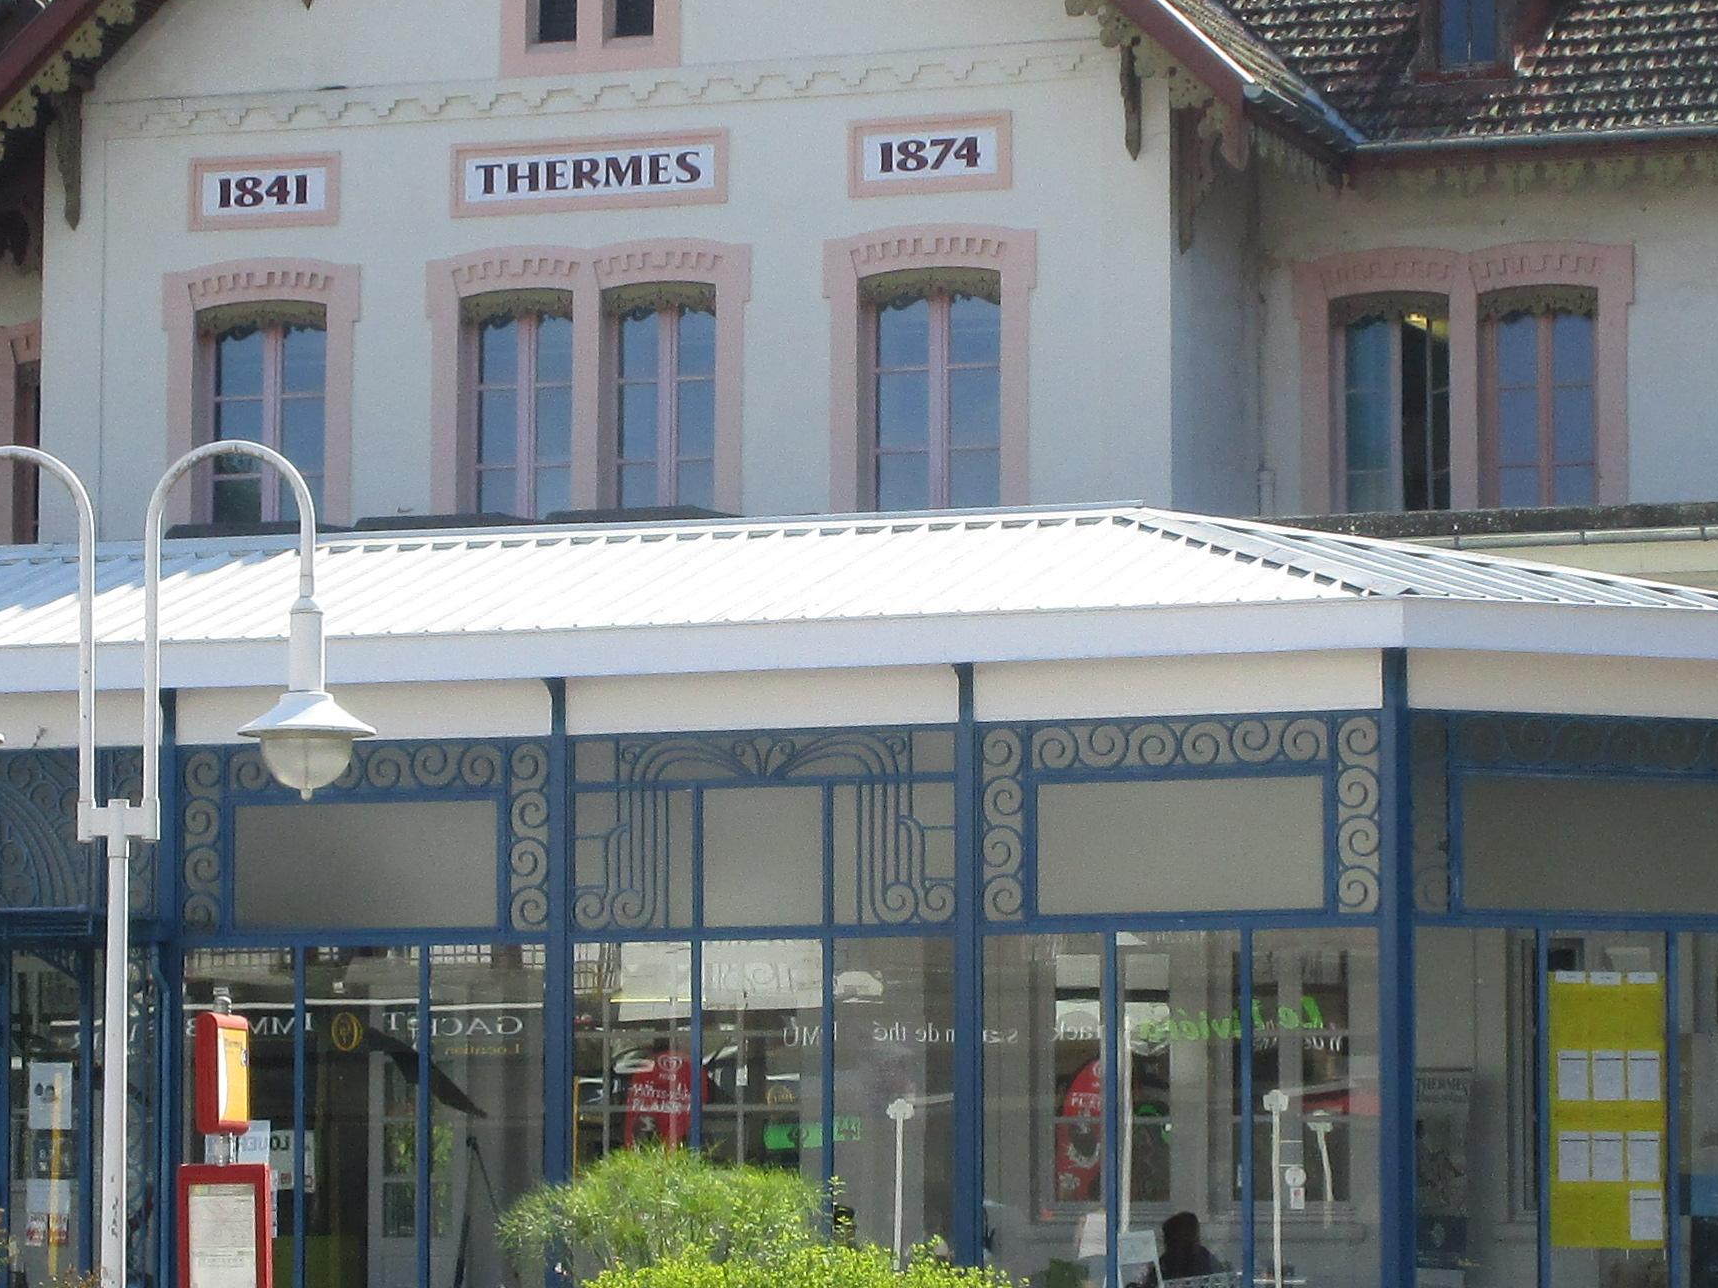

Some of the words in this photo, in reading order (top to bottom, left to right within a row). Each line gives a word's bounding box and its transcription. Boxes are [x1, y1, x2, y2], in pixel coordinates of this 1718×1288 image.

[475, 152, 702, 194] THERMES
[879, 136, 981, 173] 1874
[218, 174, 308, 208] 1841
